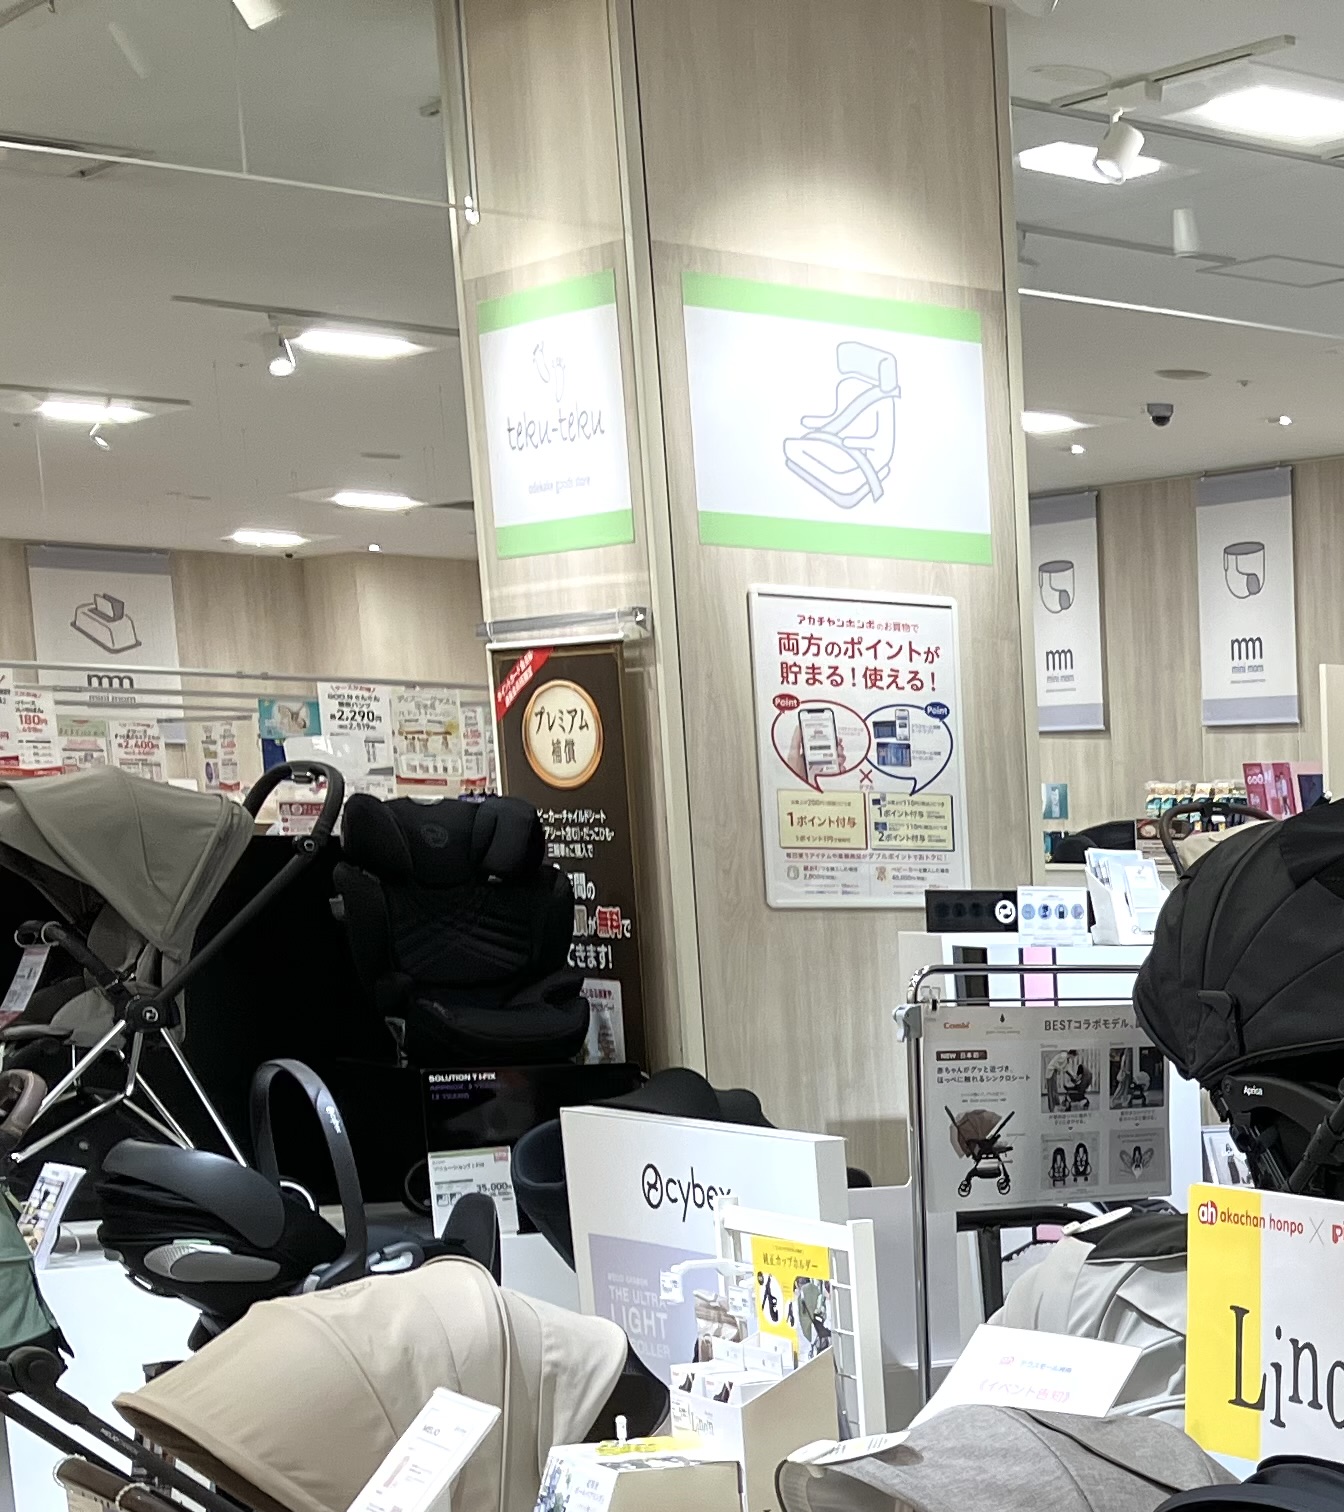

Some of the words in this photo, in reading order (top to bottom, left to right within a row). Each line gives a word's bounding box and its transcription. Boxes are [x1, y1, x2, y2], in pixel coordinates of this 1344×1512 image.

[777, 631, 941, 665] 両方のポイントが
[534, 706, 590, 735] プレミアム
[1219, 1209, 1266, 1230] akachan
[1269, 1214, 1304, 1237] honpo
